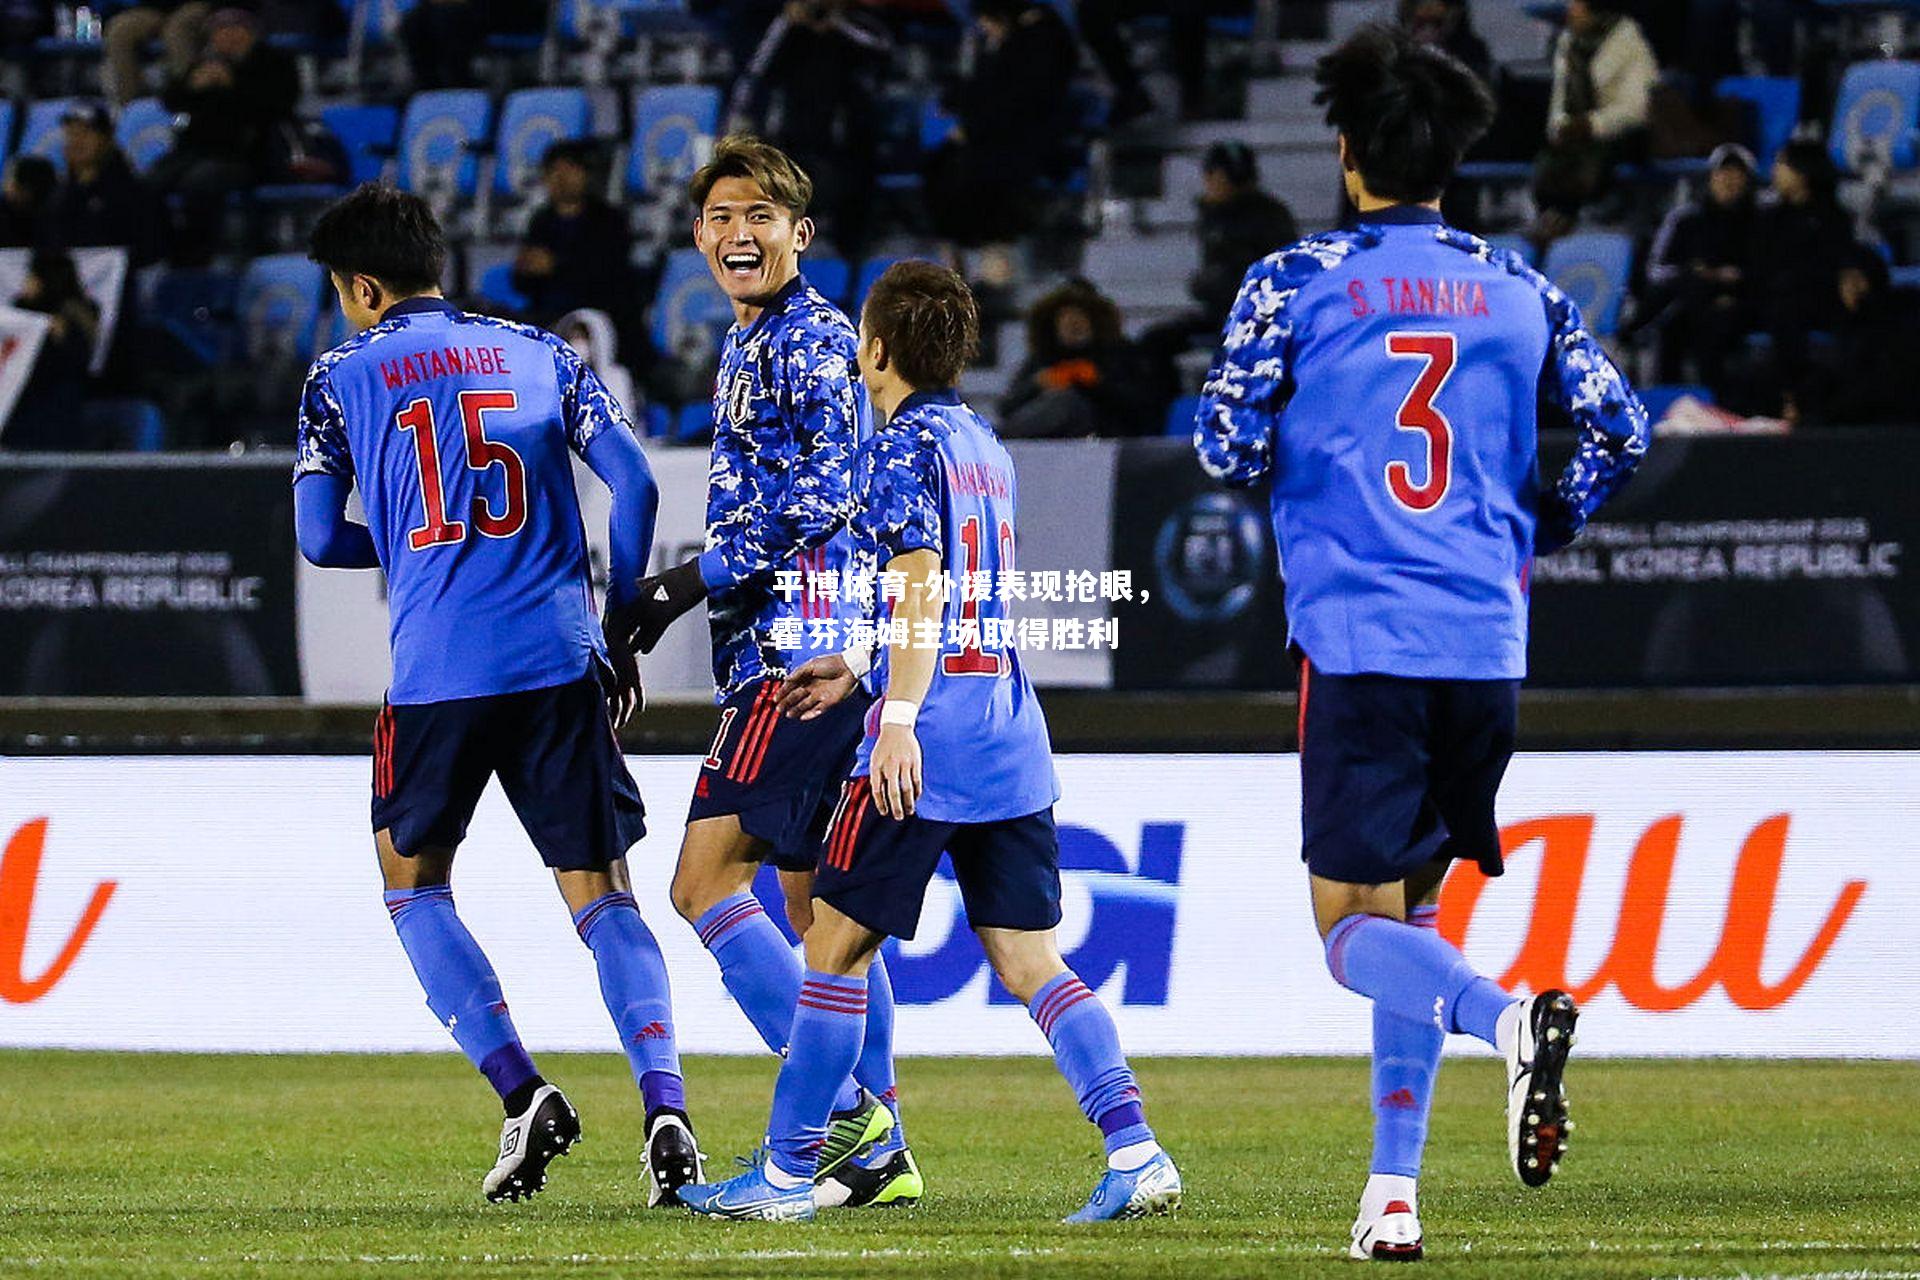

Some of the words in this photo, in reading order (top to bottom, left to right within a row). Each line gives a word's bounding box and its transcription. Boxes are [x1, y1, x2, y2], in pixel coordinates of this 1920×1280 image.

[1381, 277, 1490, 318] TANAKA
[381, 347, 511, 391] WATANABE
[1384, 331, 1458, 513] 3
[396, 390, 528, 552] 15
[1610, 546, 1728, 582] KOREA
[1732, 542, 1900, 580] REPUBLIC
[0, 576, 97, 610] OREA
[101, 575, 264, 611] REPUBLIC
[1436, 812, 1868, 1013] au
